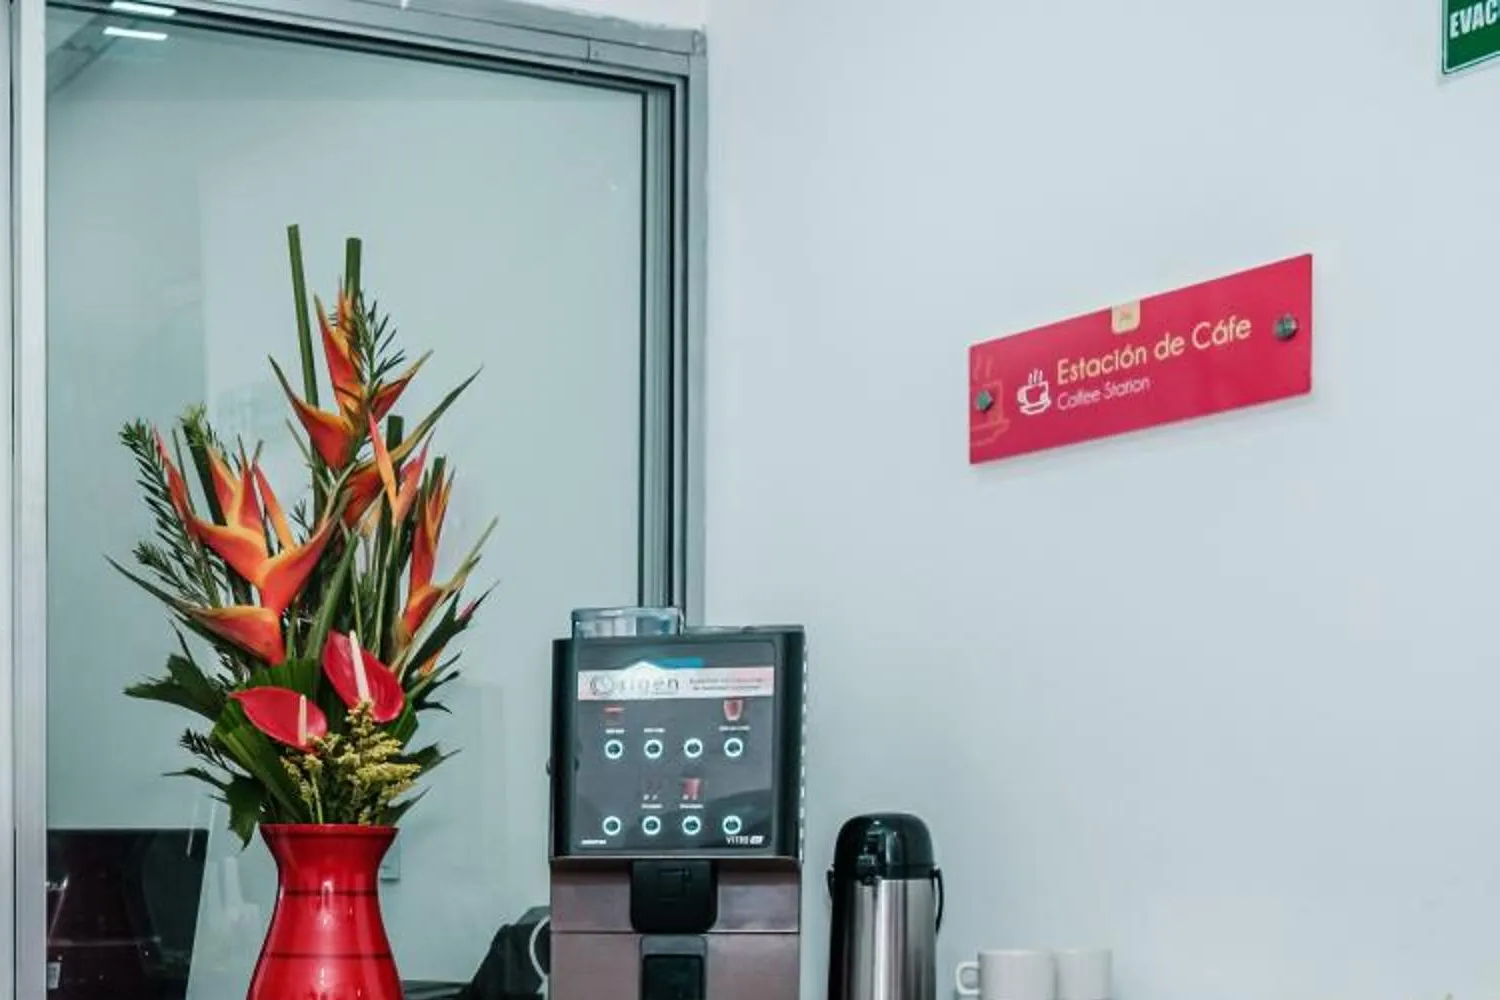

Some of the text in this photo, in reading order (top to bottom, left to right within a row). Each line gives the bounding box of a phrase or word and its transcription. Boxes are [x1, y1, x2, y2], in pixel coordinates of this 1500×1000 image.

[1057, 344, 1148, 385] Estación
[1153, 332, 1186, 360] de
[1057, 376, 1151, 411] Coffee Station
